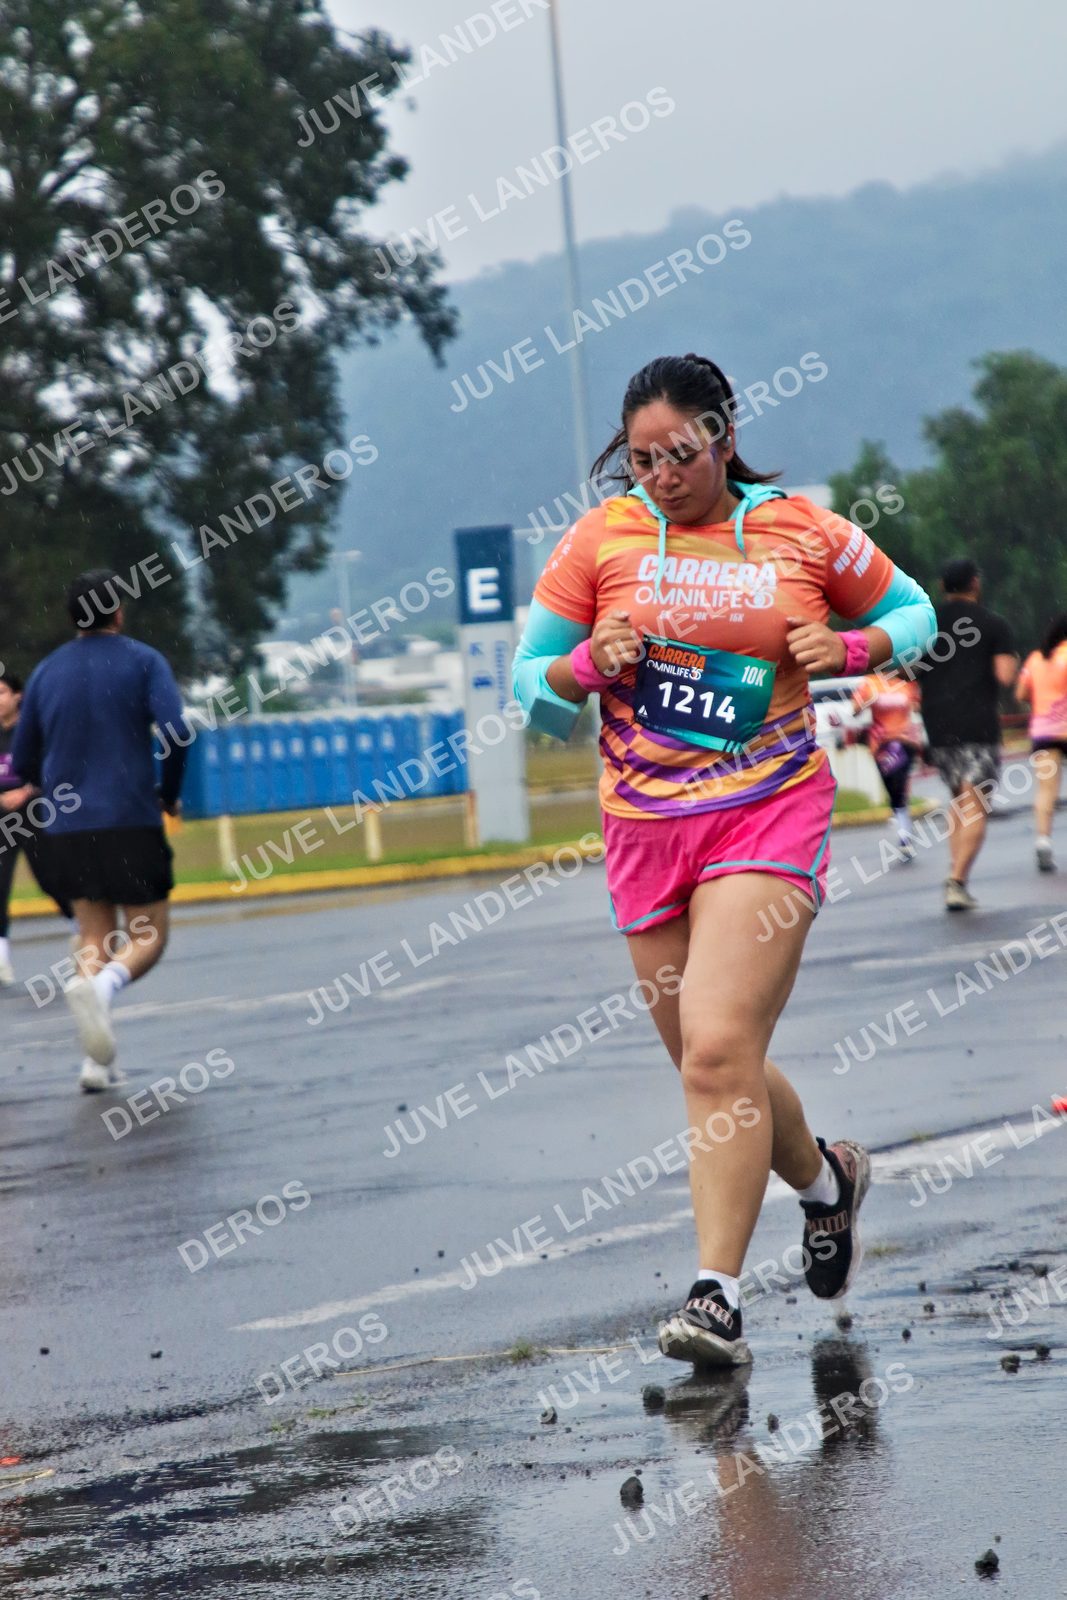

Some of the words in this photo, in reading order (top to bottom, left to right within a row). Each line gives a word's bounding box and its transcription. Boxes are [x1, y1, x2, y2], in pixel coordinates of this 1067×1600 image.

[638, 554, 777, 588] CARRERA
[467, 567, 501, 613] E
[649, 645, 706, 669] CARRERA
[741, 665, 767, 687] 10K
[658, 682, 736, 723] 1214
